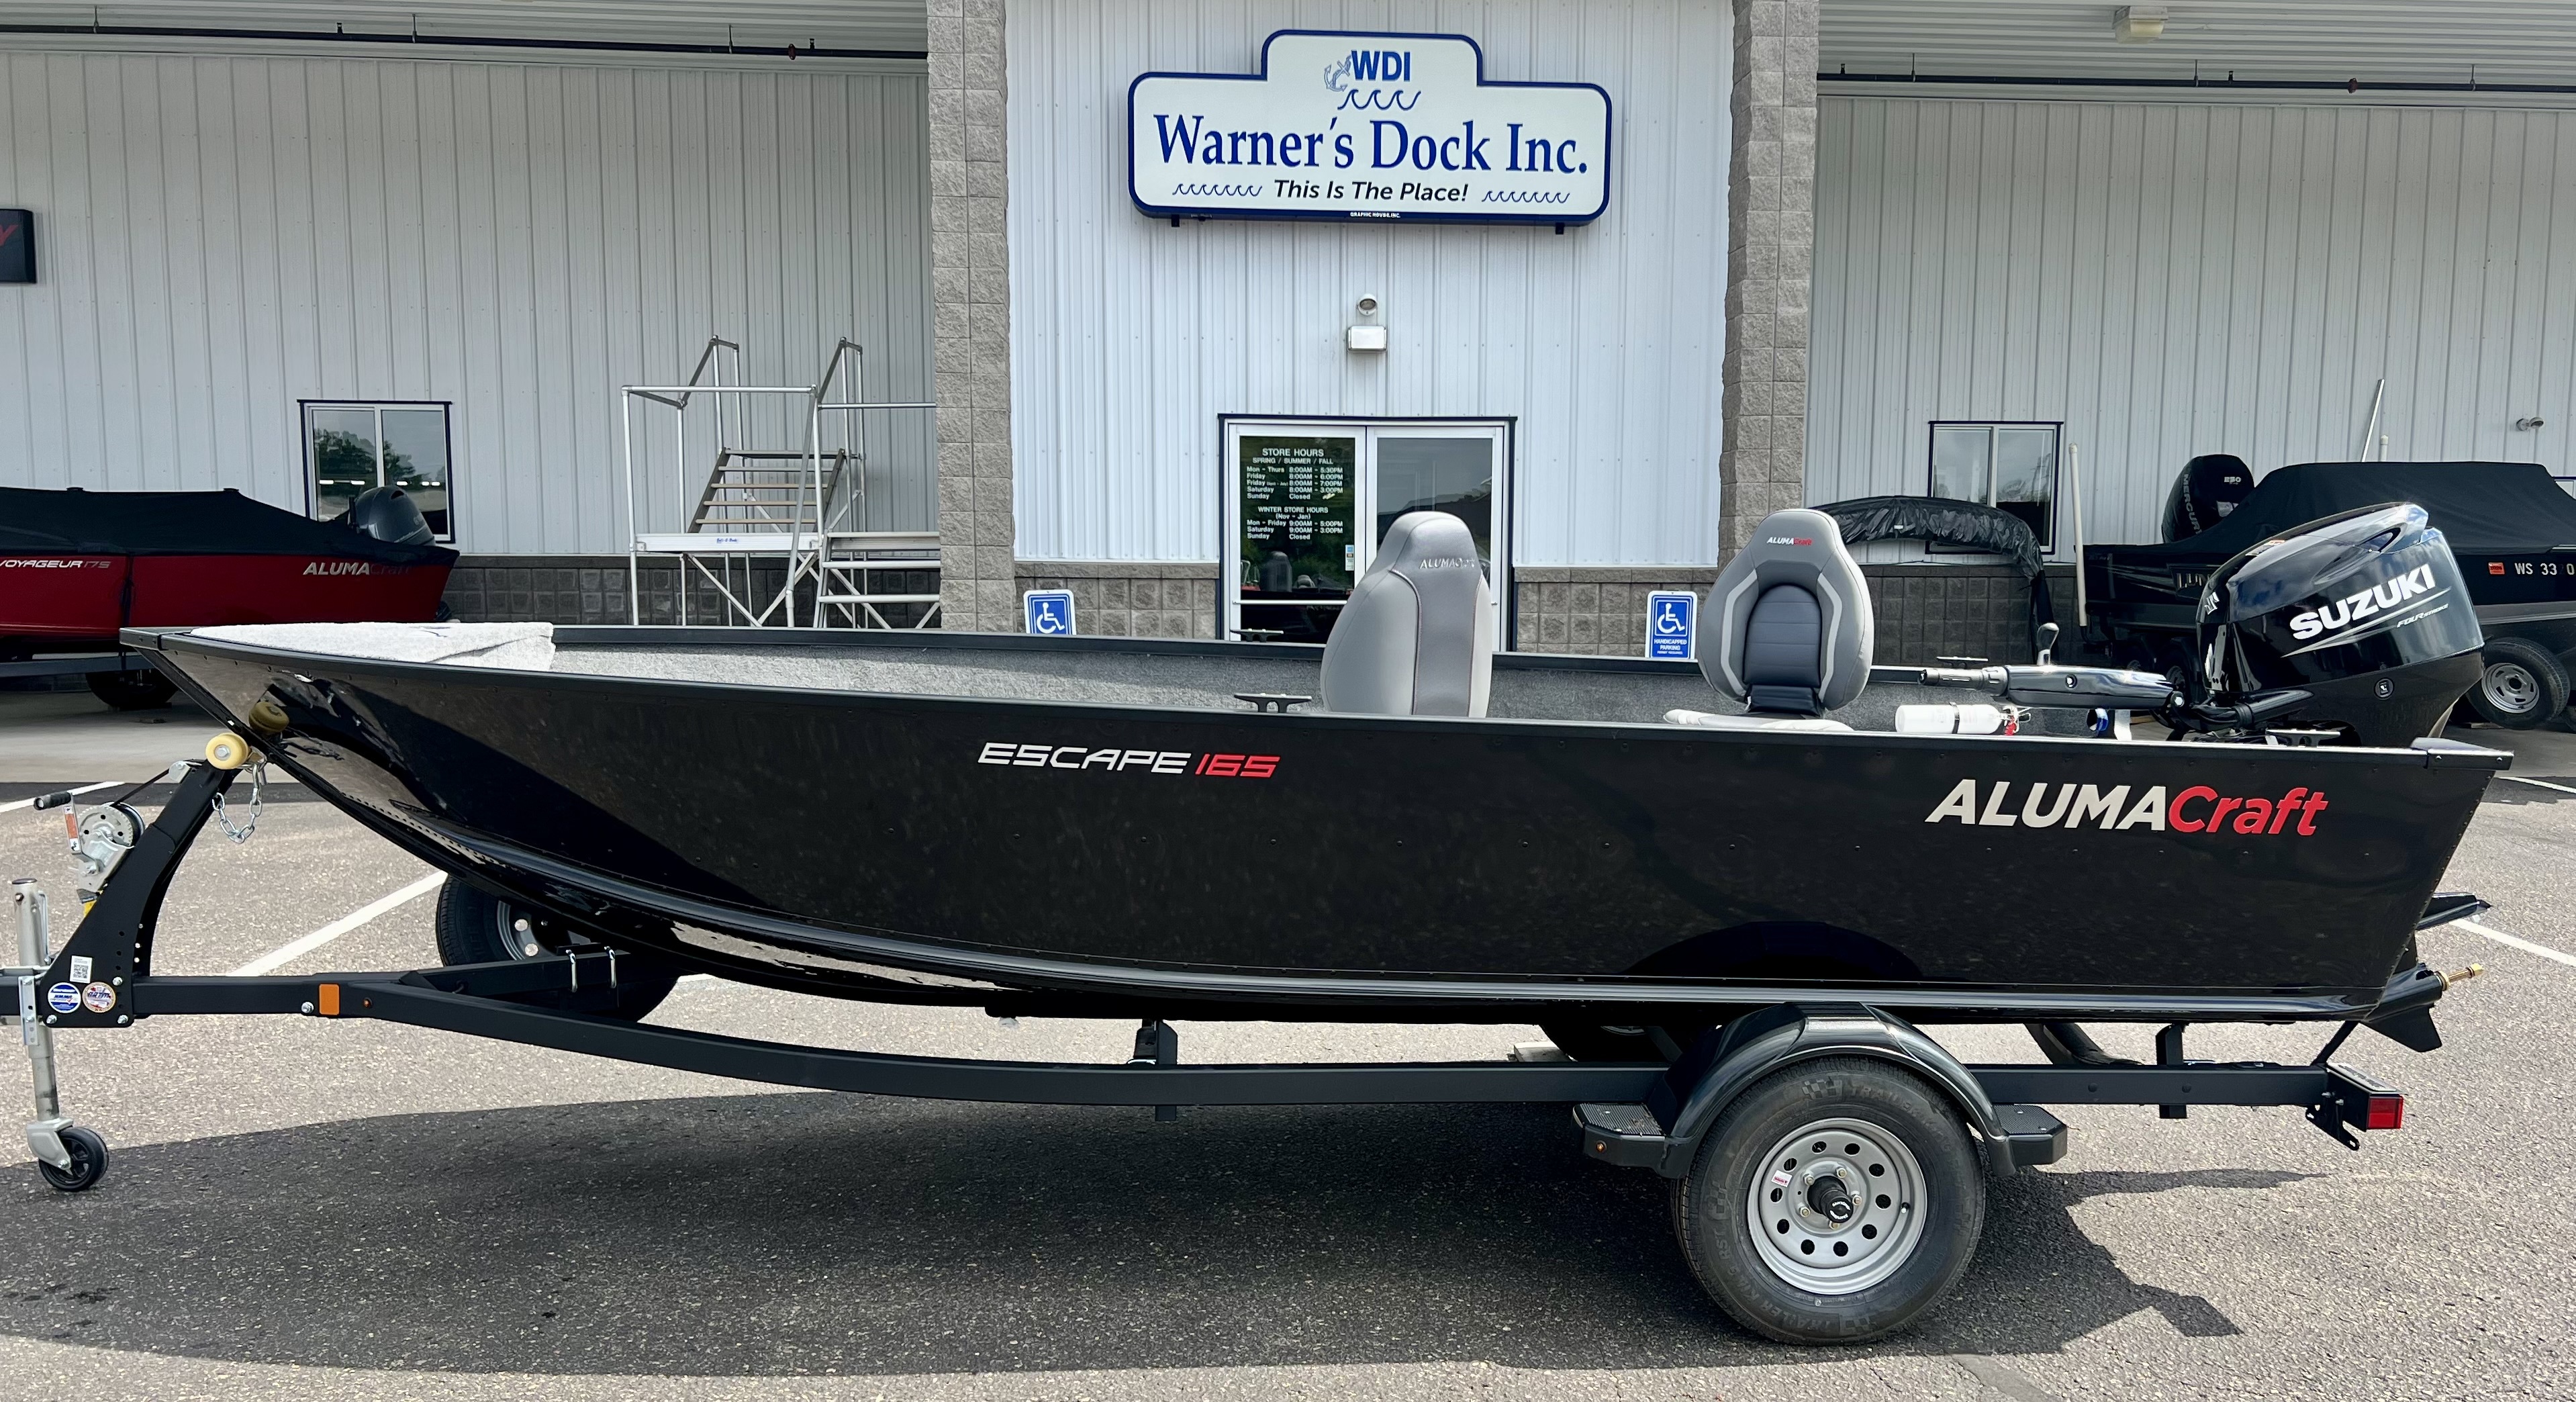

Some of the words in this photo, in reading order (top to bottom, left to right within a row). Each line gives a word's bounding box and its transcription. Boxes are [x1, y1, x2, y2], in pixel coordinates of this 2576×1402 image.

[1351, 50, 1411, 82] WDI
[1153, 114, 1354, 169] Warner's
[1370, 120, 1490, 173] Dock
[1505, 123, 1588, 174] Inc.
[1275, 180, 1319, 199] This
[1327, 181, 1344, 200] Is
[1352, 182, 1393, 201] The
[1400, 183, 1469, 203] Place!
[1262, 448, 1291, 457] STORE
[1294, 448, 1324, 457] HOURS
[2177, 573, 2210, 590] LUN
[2514, 563, 2533, 575] WS
[2289, 564, 2436, 640] SUZUKI
[977, 742, 1192, 774] ESCAPE
[1195, 752, 1281, 778] 165
[1924, 778, 2329, 836] ALUMACraft
